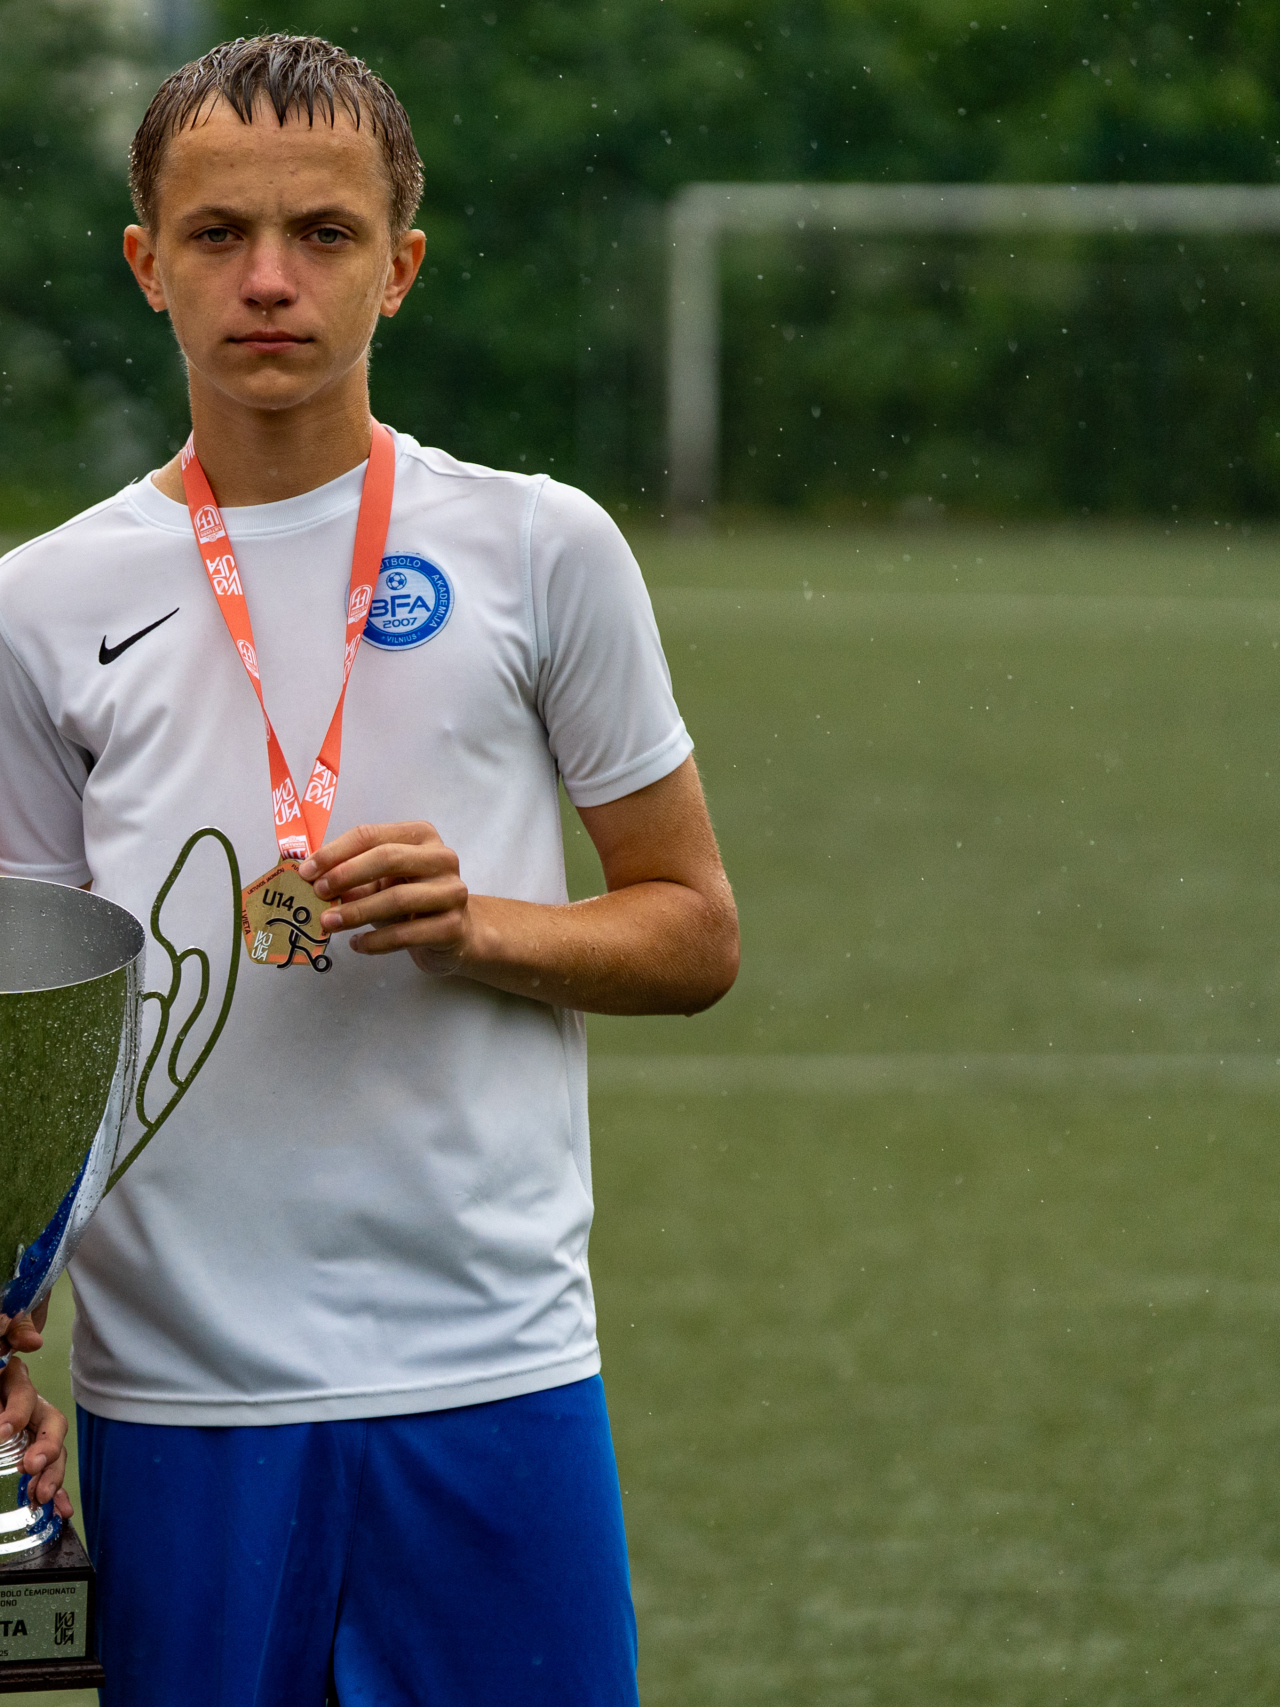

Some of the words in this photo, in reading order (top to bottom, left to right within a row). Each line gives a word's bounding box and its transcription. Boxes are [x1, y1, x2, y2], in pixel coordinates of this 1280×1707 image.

[368, 594, 431, 618] BFA
[429, 574, 448, 628] AKADEMIJA
[382, 617, 418, 629] 2007
[387, 633, 417, 644] VILNIUS
[262, 888, 295, 912] U14
[242, 913, 252, 936] VIETA
[23, 1587, 76, 1597] ČEMPIONATO
